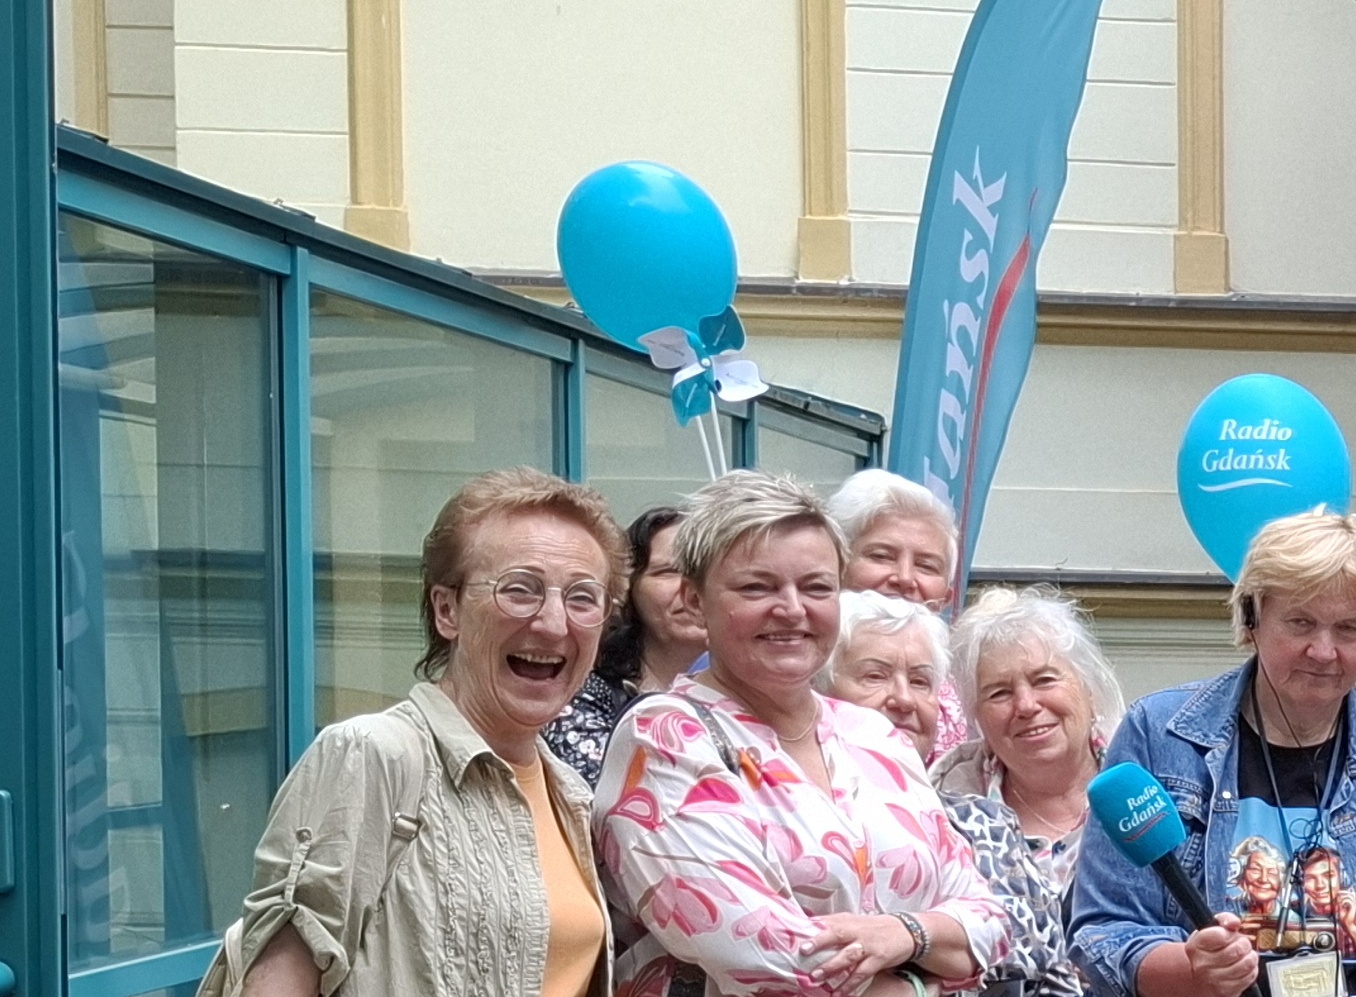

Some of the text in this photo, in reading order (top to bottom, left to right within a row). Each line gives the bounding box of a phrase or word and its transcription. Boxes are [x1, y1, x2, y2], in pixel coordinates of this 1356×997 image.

[1218, 418, 1293, 441] Radio
[1202, 447, 1292, 472] Gdańsk
[1126, 785, 1158, 811] Radio
[1118, 795, 1167, 832] Gdańsk
